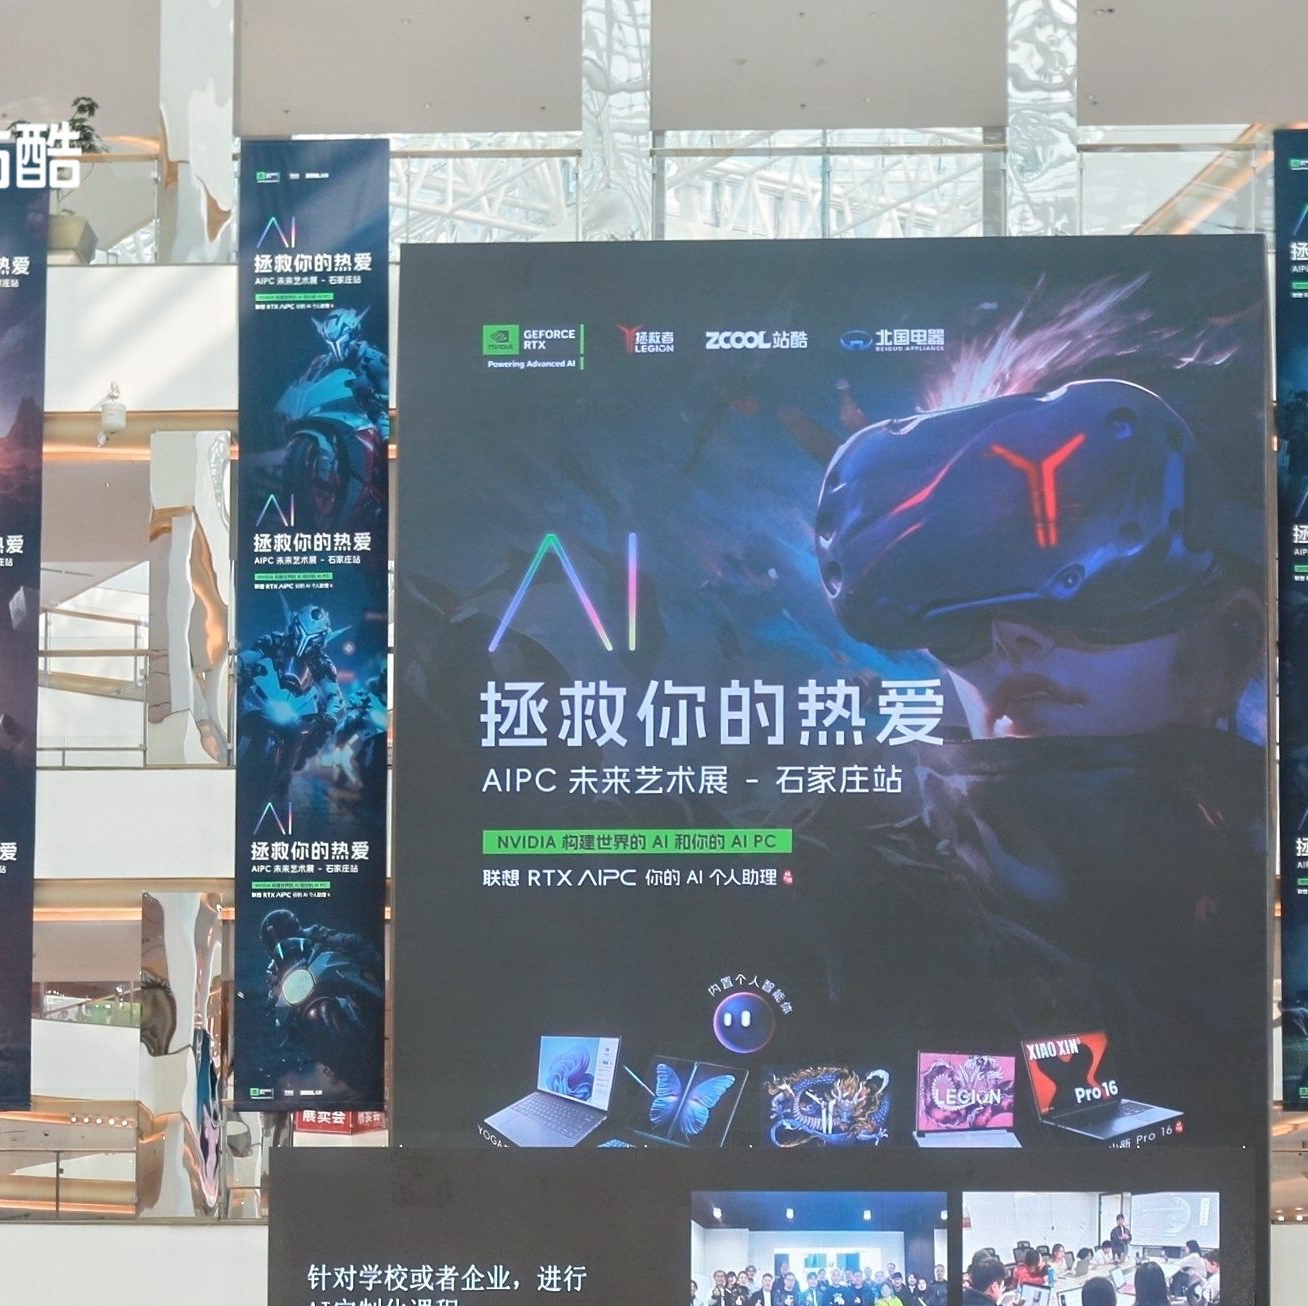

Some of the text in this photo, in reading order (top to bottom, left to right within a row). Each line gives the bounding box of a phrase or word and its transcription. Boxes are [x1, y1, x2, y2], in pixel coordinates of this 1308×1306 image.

[254, 253, 372, 273] 拯救你的热爱
[523, 329, 576, 340] GEFORCE
[635, 331, 674, 344] 拯救者
[705, 331, 808, 350] ZCOOL 站酷
[875, 328, 945, 346] 北国电器
[523, 341, 546, 350] RTX
[635, 344, 674, 353] LEGION
[488, 360, 576, 370] Powering Advanced AI
[254, 532, 372, 553] 拯救你的热爱
[490, 533, 637, 652] AI
[480, 680, 945, 748] 拯救你的热爱
[481, 765, 904, 796] AIPC 未来艺术展 石家庄站
[251, 842, 370, 862] 拯救你的热爱
[497, 831, 777, 852] NVIDIA 构建世界的 AI 和你的 AI PC
[481, 867, 778, 888] 联想 RTX AIPC 你的 AI 个人助理
[707, 973, 794, 1016] 内置个人智能体
[1026, 1038, 1079, 1061] XIAO XIN
[933, 1086, 1003, 1107] LEGION
[1075, 1080, 1118, 1104] Pro 16
[1136, 1125, 1173, 1148] Pro 16
[307, 1264, 587, 1293] 针对学校或者企业，进行
